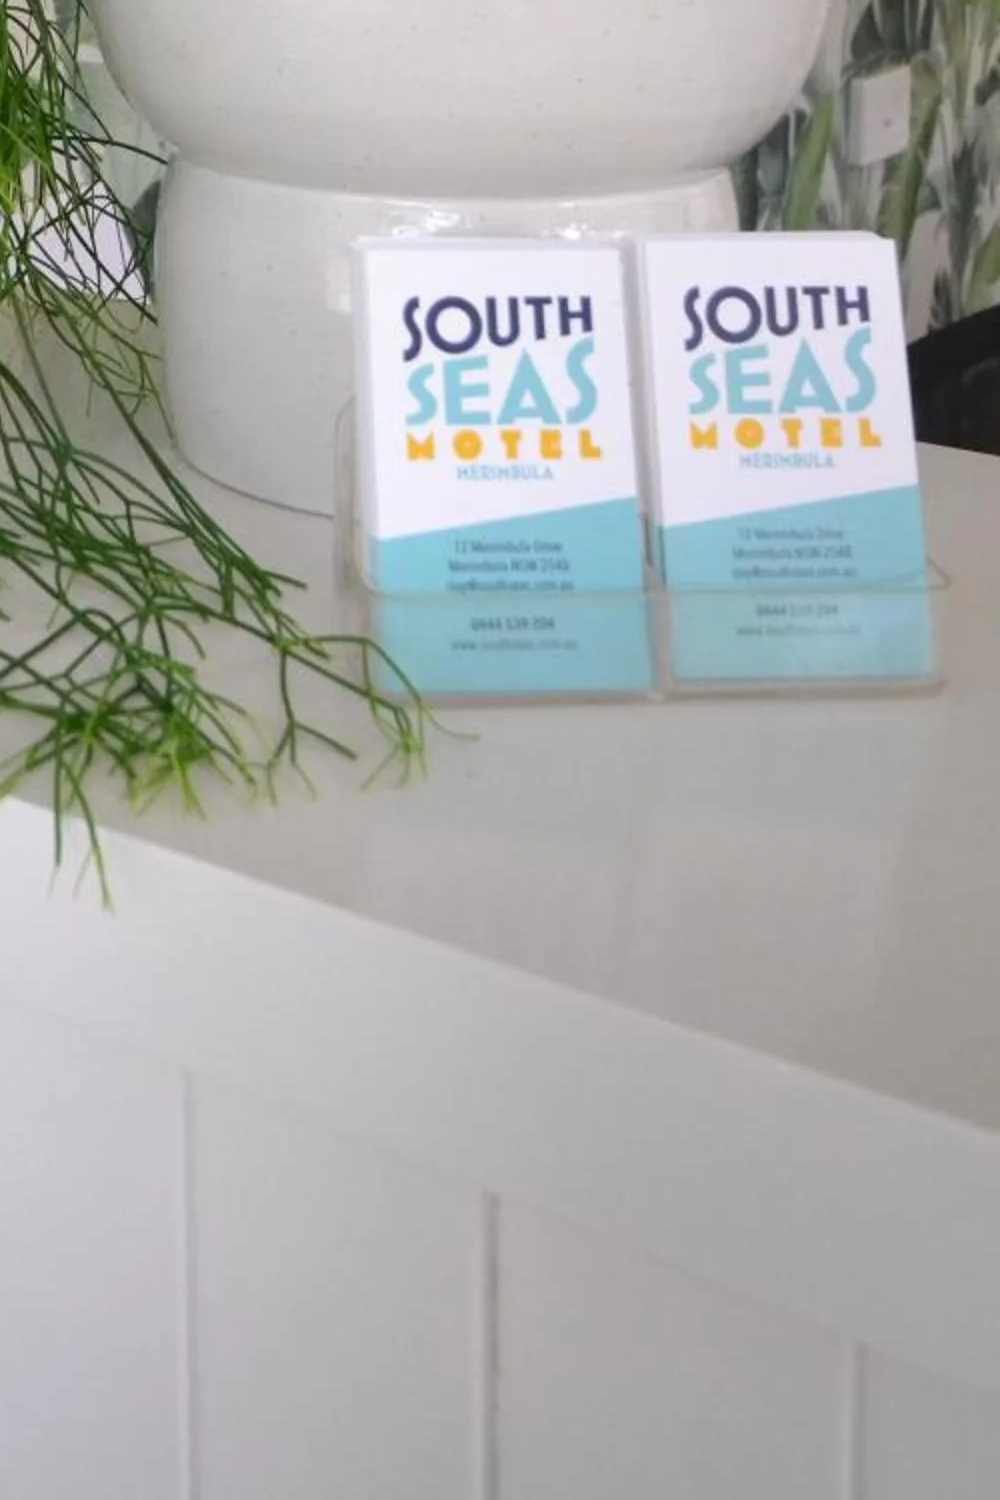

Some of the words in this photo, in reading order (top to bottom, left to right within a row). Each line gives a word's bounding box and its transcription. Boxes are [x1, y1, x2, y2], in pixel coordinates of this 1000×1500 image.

[402, 295, 594, 362] SOUTH
[683, 285, 871, 351] SOUTH
[405, 336, 598, 426] SEAS
[688, 326, 877, 415] SEAS
[406, 429, 602, 461] MOTEL
[689, 418, 882, 449] MOTEL
[456, 464, 555, 481] MERIMBULA
[739, 451, 836, 469] MERIMBULA
